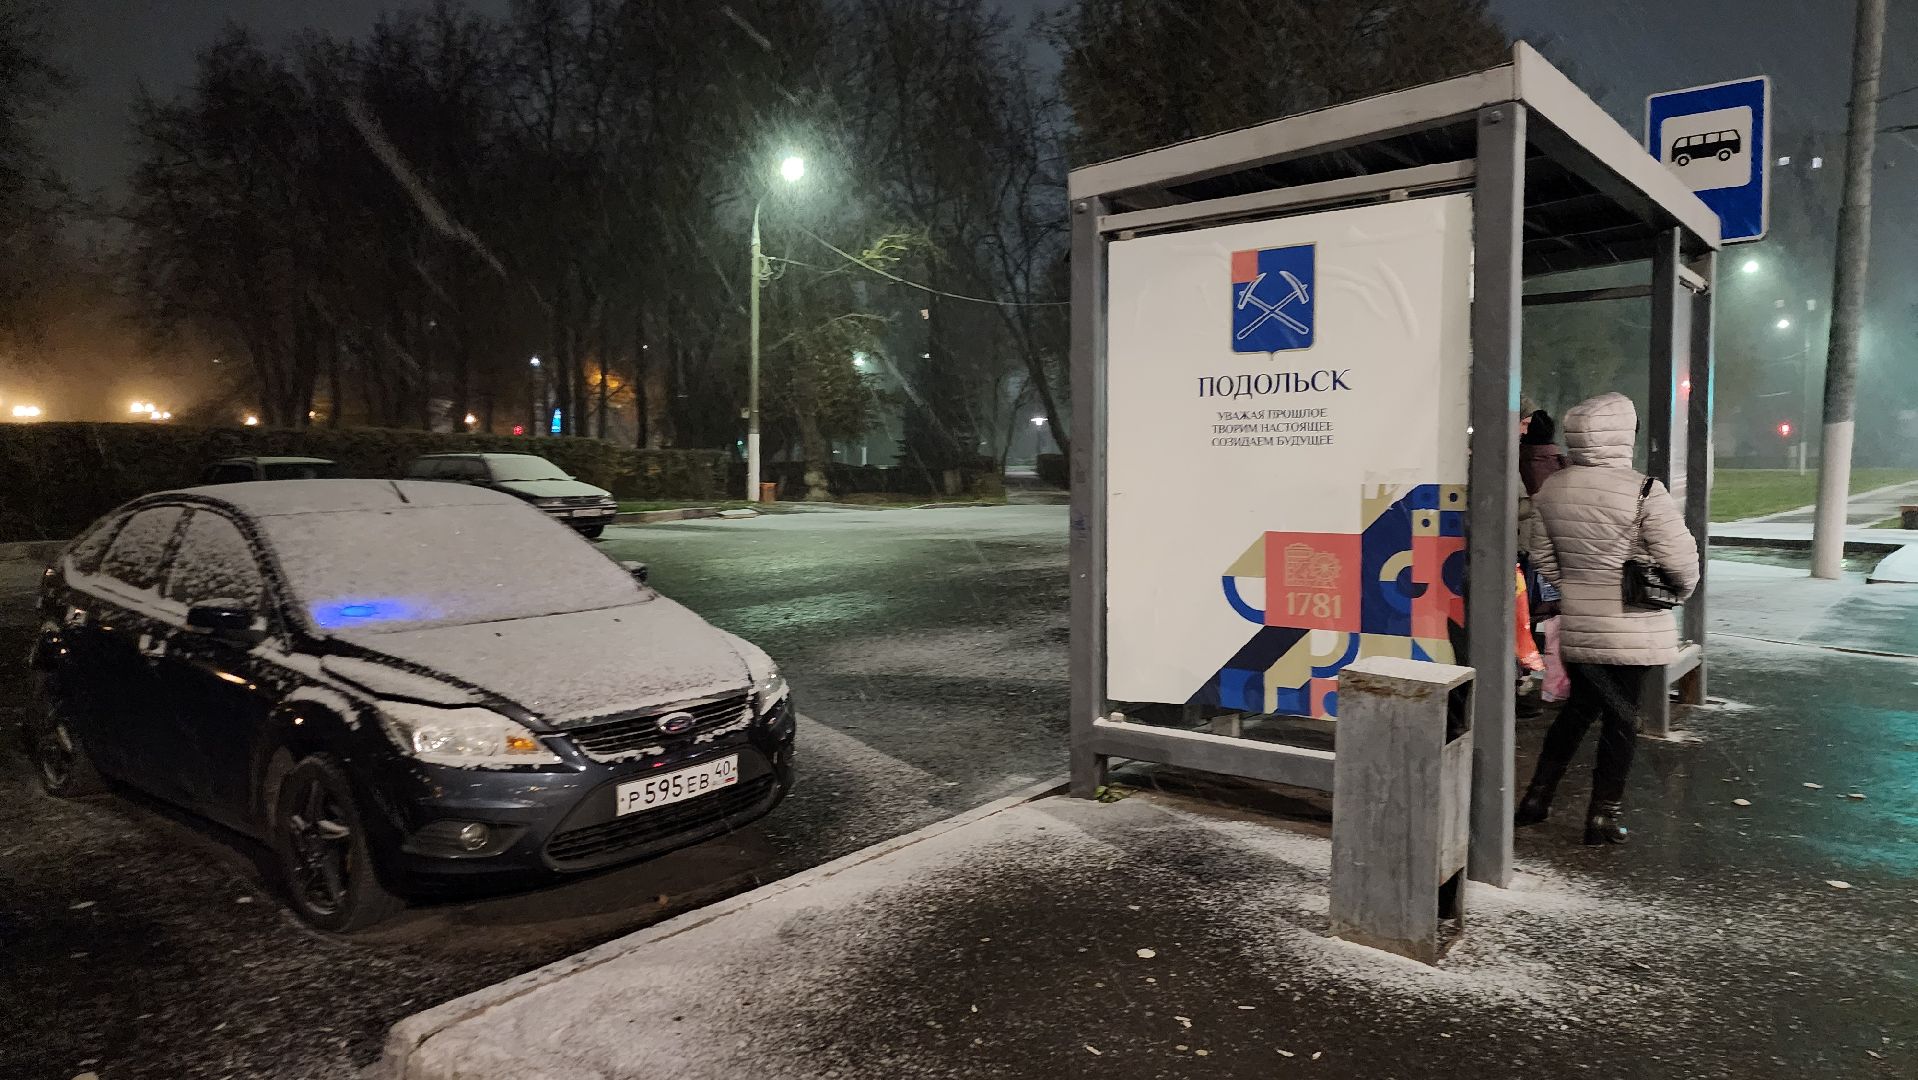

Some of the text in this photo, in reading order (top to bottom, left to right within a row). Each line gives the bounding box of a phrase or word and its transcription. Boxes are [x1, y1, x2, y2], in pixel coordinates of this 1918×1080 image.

[1198, 369, 1352, 400] ПОДОЛЬСК
[1216, 408, 1328, 421] УВАЖАЯ ПРОШЛОЕ
[1212, 421, 1334, 434] ТВОРИМ НАСТОЯЩЕЕ
[1212, 434, 1334, 447] СОЗИДАЕМ БУДУЩЕЕ
[1286, 592, 1343, 619] 1781
